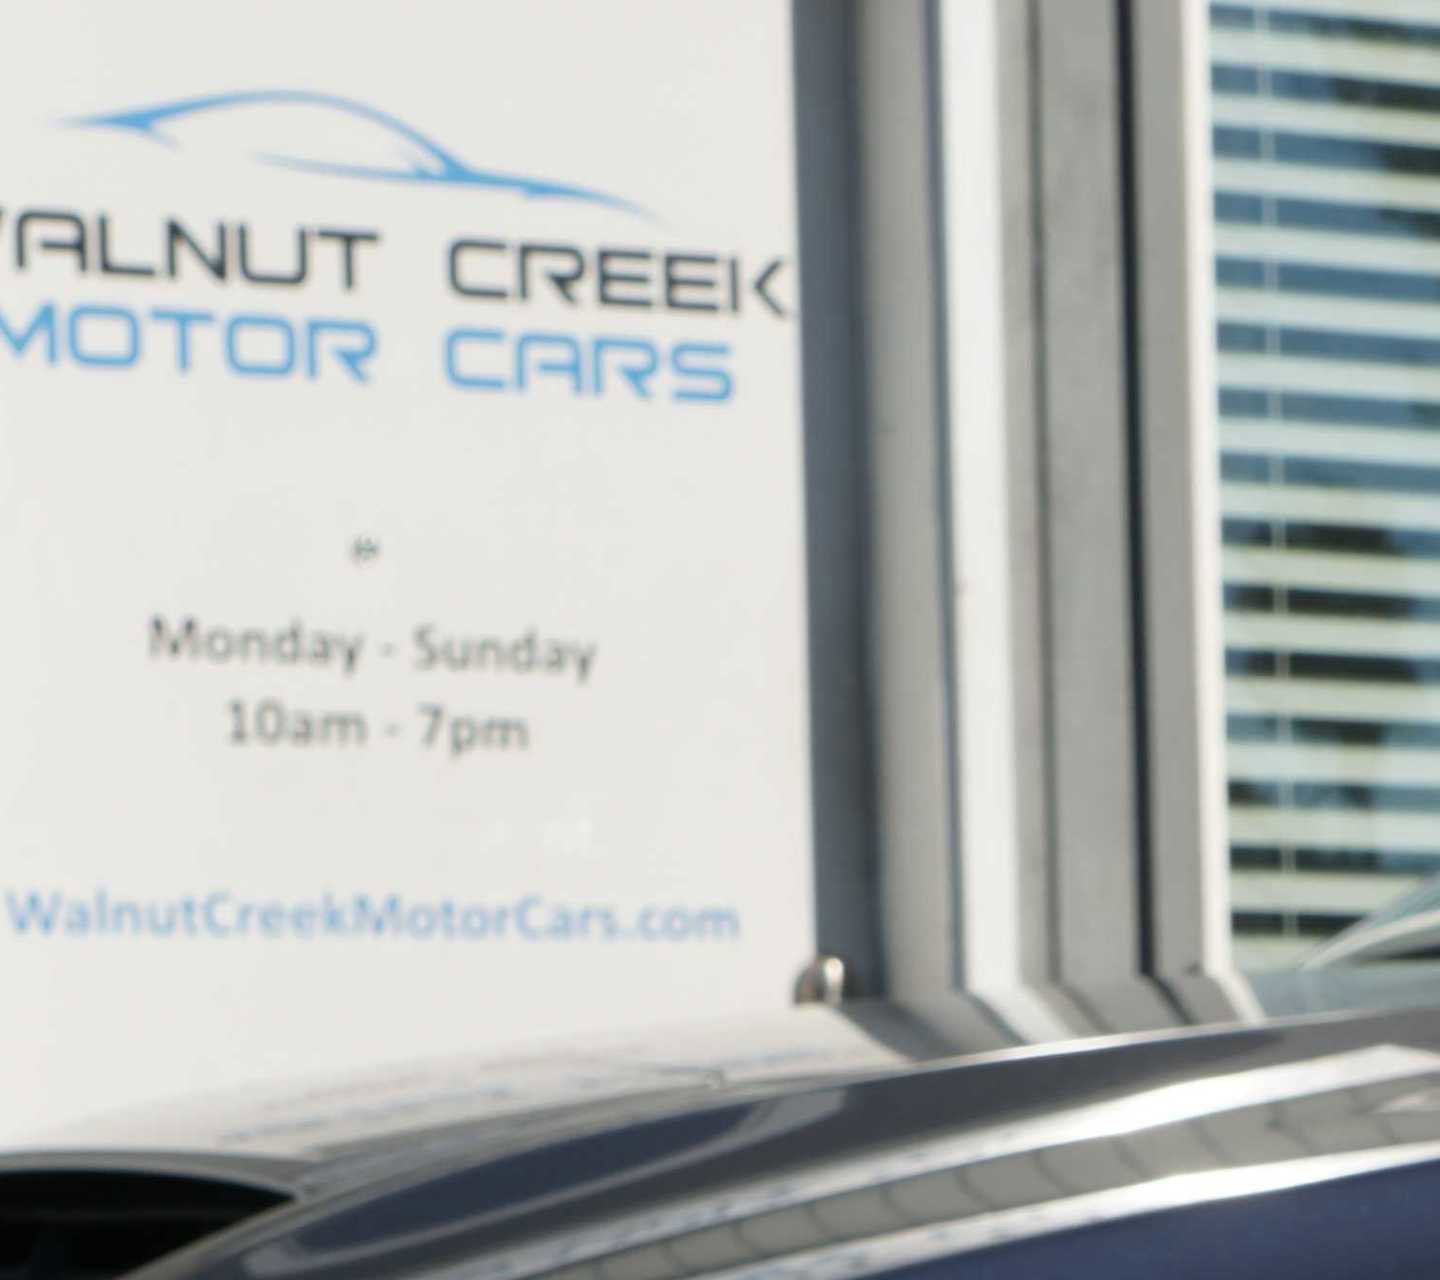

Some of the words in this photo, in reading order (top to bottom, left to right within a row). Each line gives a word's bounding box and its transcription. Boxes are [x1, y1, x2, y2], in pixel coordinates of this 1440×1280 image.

[446, 238, 795, 318] CREEK
[443, 326, 734, 404] CARS
[149, 615, 361, 674] Monday
[413, 625, 595, 683] Sunday
[228, 699, 367, 747] 10am
[420, 704, 529, 756] 7pm
[7, 889, 739, 942] WalnutCreekMotorCars.com
